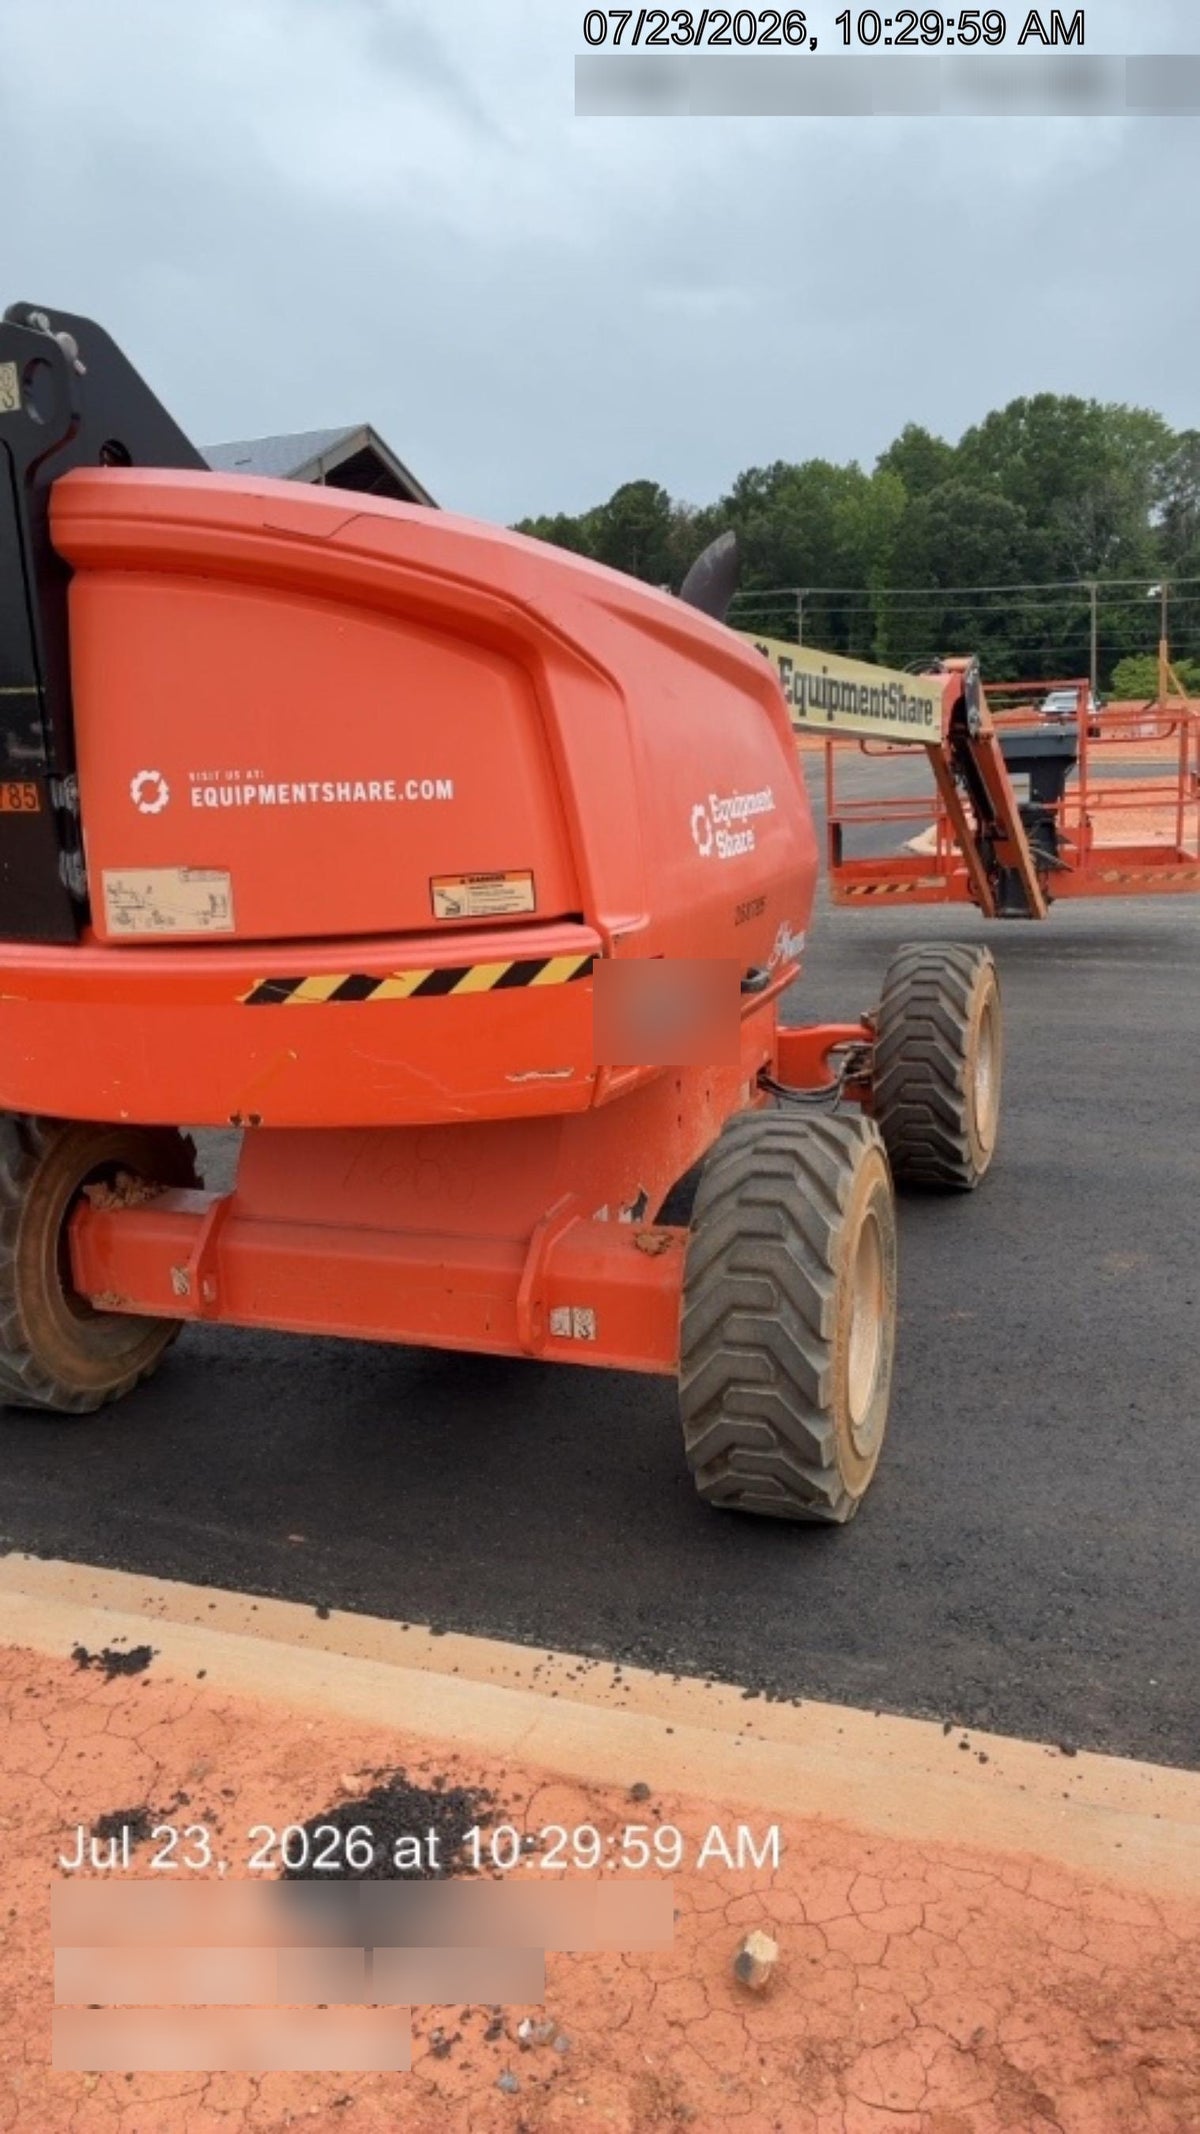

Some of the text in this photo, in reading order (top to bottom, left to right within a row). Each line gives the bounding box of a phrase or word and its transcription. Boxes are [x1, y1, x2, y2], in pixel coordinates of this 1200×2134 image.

[777, 656, 934, 726] EquipmentShare
[0, 783, 37, 809] 85
[191, 779, 454, 808] EQUIPMENTSHARE.COM
[708, 785, 776, 828] Equipment
[715, 828, 756, 859] Share
